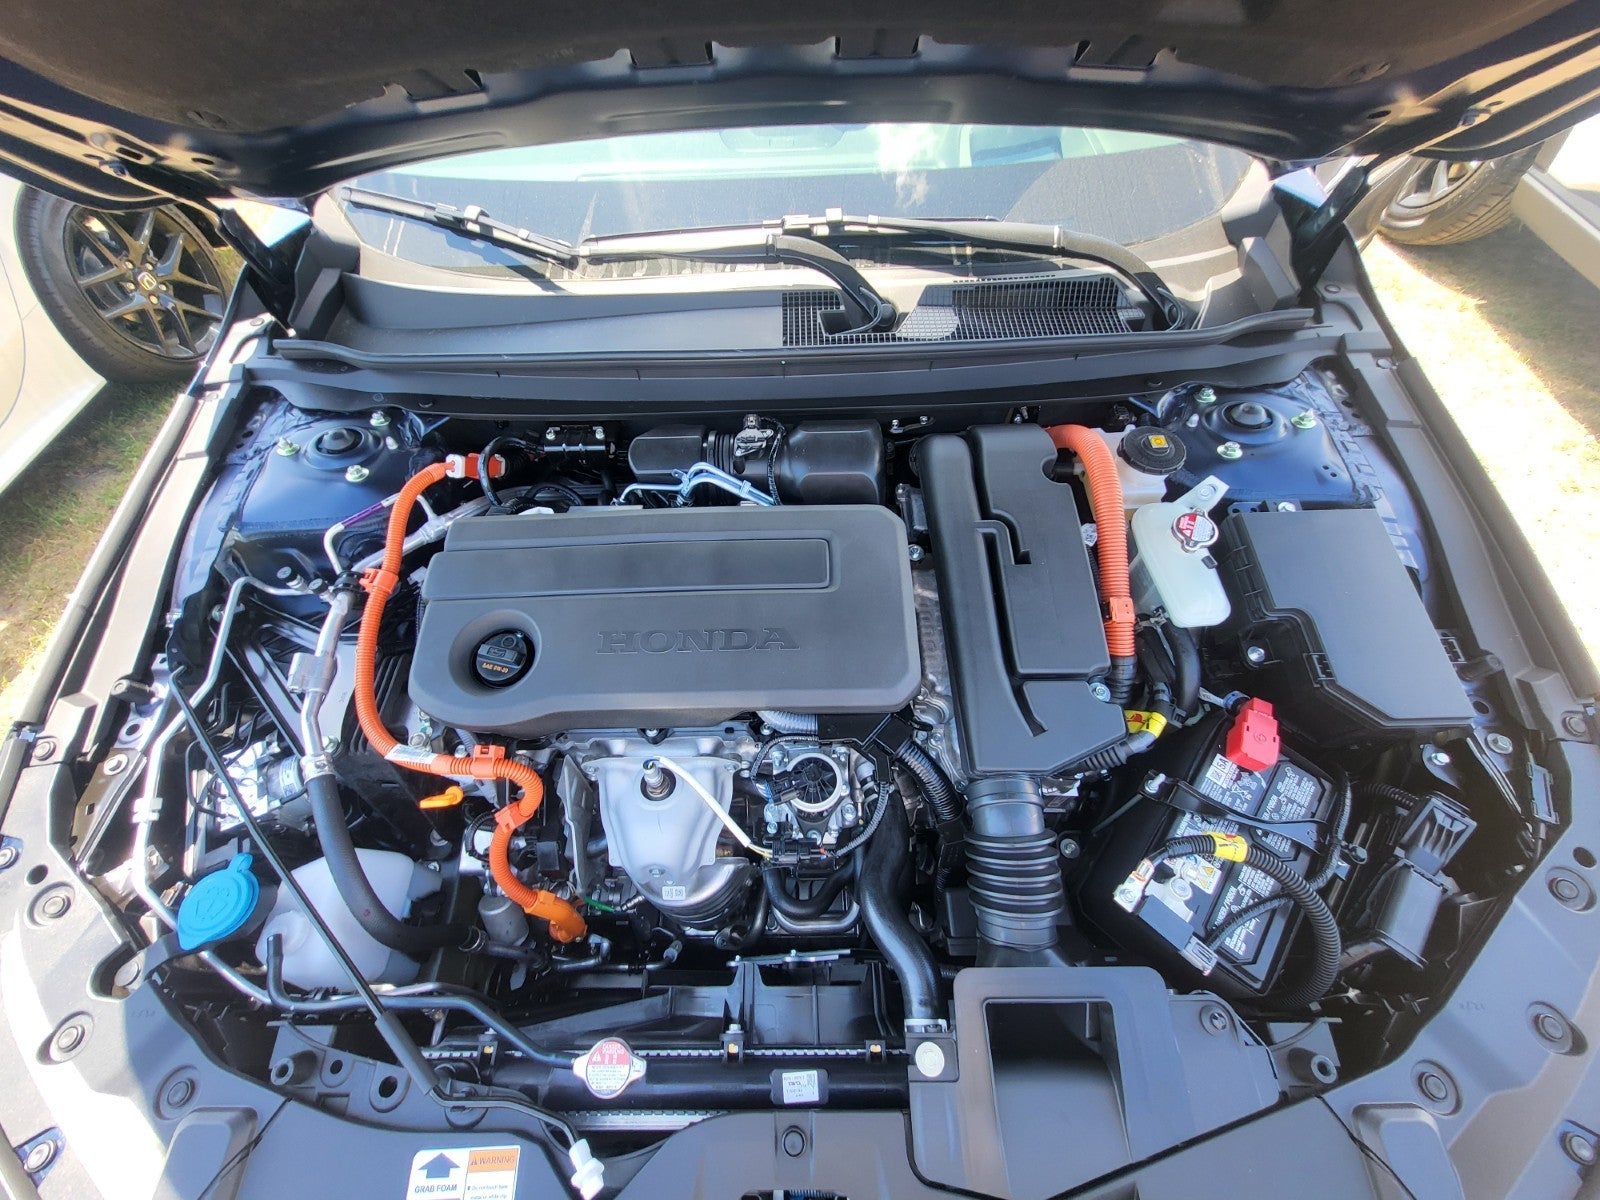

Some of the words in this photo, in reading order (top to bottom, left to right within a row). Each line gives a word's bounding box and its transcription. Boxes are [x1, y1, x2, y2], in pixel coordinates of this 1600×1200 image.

[595, 627, 801, 655] HONDA
[1216, 758, 1229, 770] 5A
[479, 1155, 515, 1165] WARNING
[414, 1184, 435, 1194] GRAB
[436, 1183, 458, 1192] FOAM
